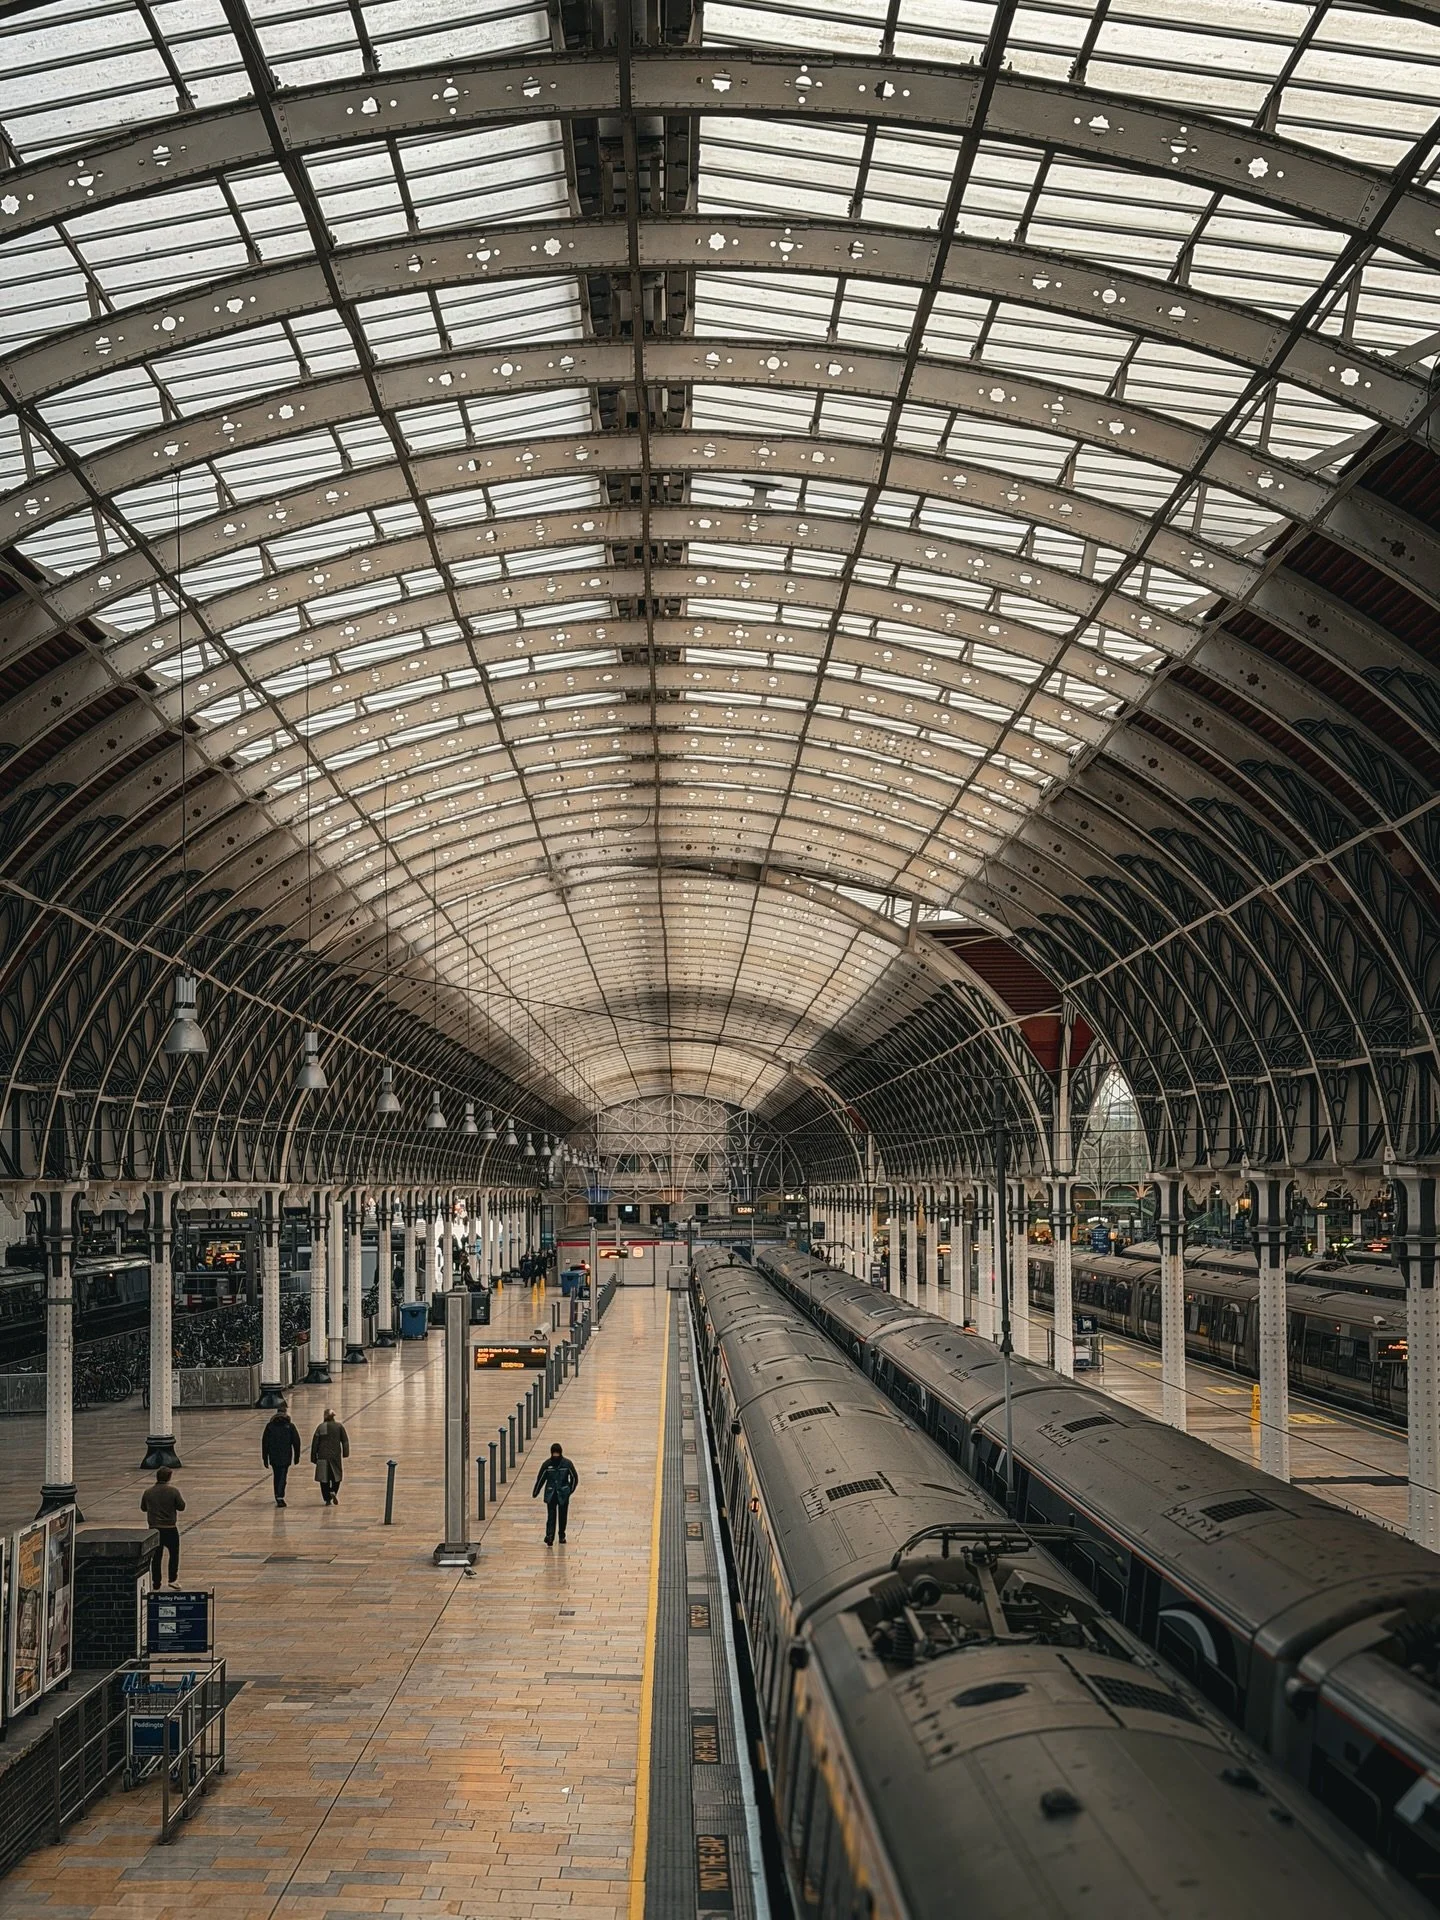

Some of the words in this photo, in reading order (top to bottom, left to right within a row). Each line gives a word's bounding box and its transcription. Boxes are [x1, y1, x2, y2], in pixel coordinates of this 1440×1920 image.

[134, 1721, 164, 1729] Paddingto
[698, 1836, 725, 1854] GAP
[699, 1855, 727, 1870] THE
